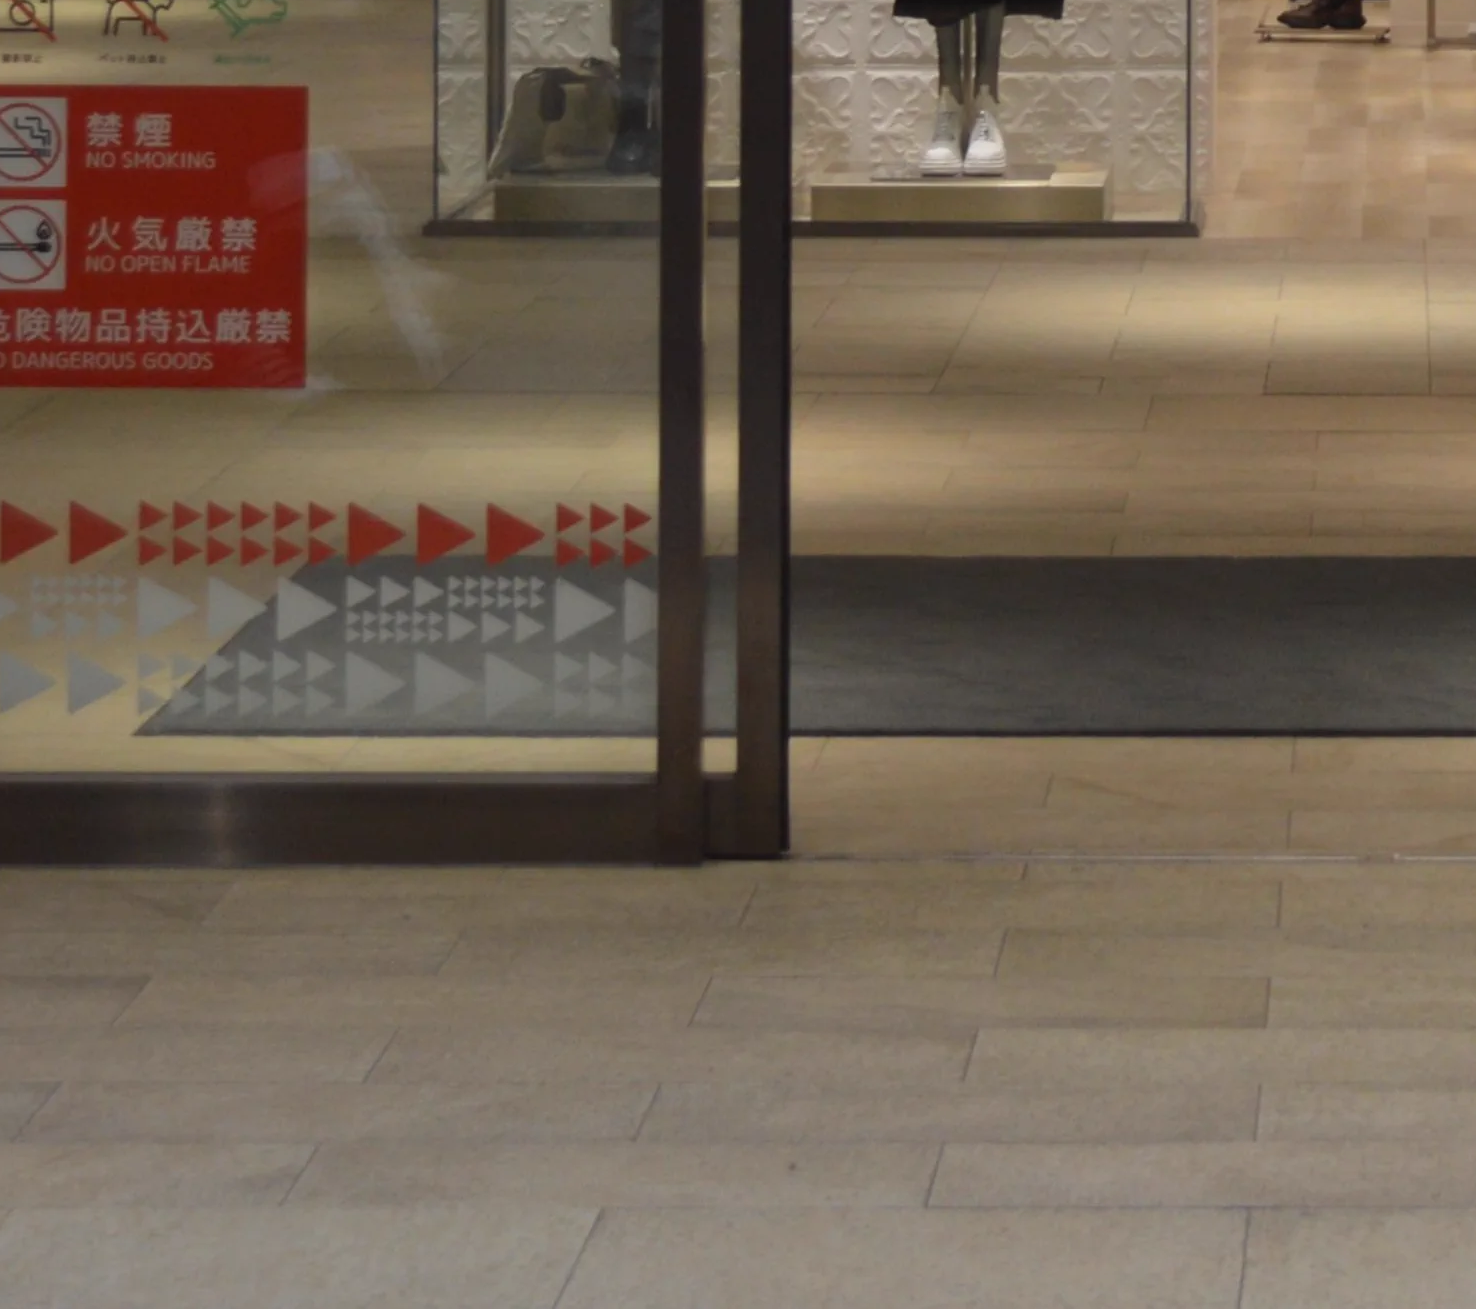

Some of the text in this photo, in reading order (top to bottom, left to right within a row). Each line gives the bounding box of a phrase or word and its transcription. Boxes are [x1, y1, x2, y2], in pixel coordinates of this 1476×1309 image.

[85, 113, 173, 148] 禁煙
[85, 151, 217, 170] NO SMOKING
[86, 217, 257, 253] 火気厳禁
[85, 255, 252, 274] NO OPEN FLAME
[12, 351, 136, 370] DANGEROUS
[142, 351, 214, 370] GOODS
